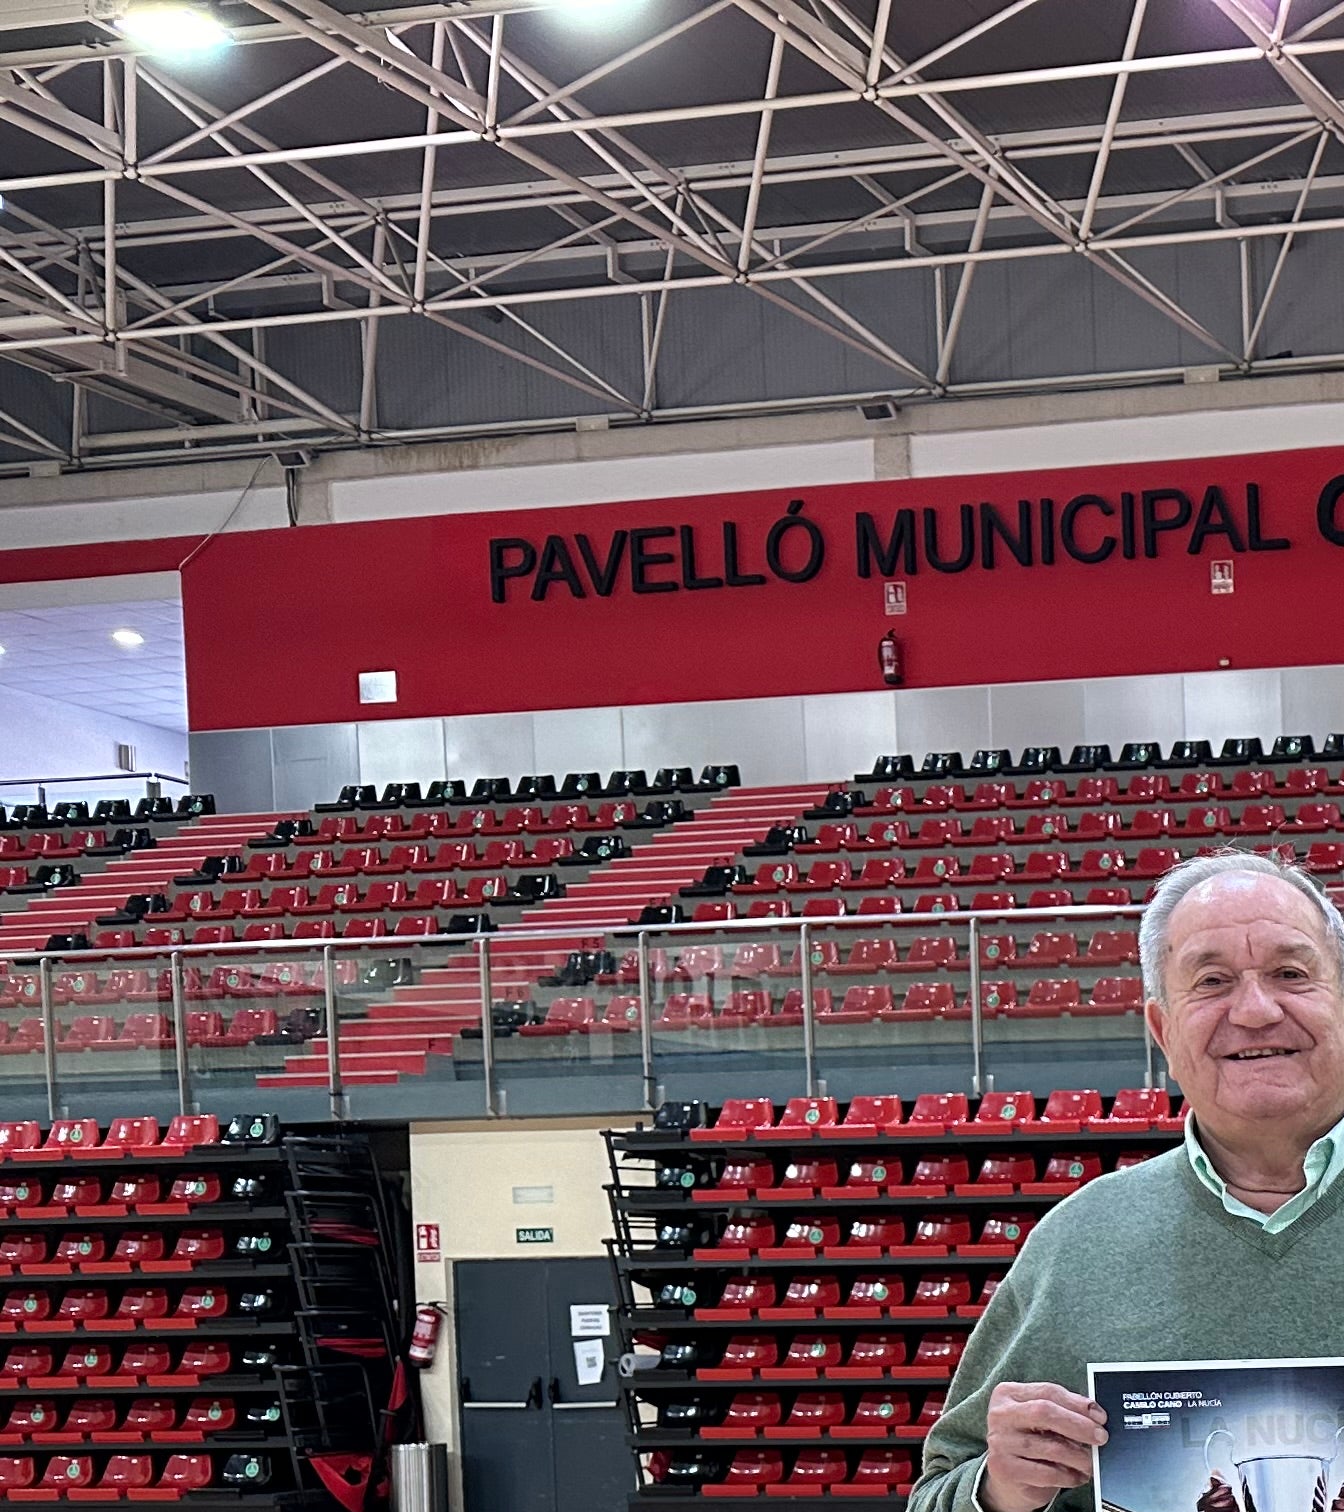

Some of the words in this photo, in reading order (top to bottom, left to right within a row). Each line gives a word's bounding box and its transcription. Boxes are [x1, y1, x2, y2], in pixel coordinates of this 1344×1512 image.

[489, 499, 826, 604] PAVELLÓ
[855, 482, 1291, 578] MUNICIPAL
[518, 1230, 551, 1241] SALIDA
